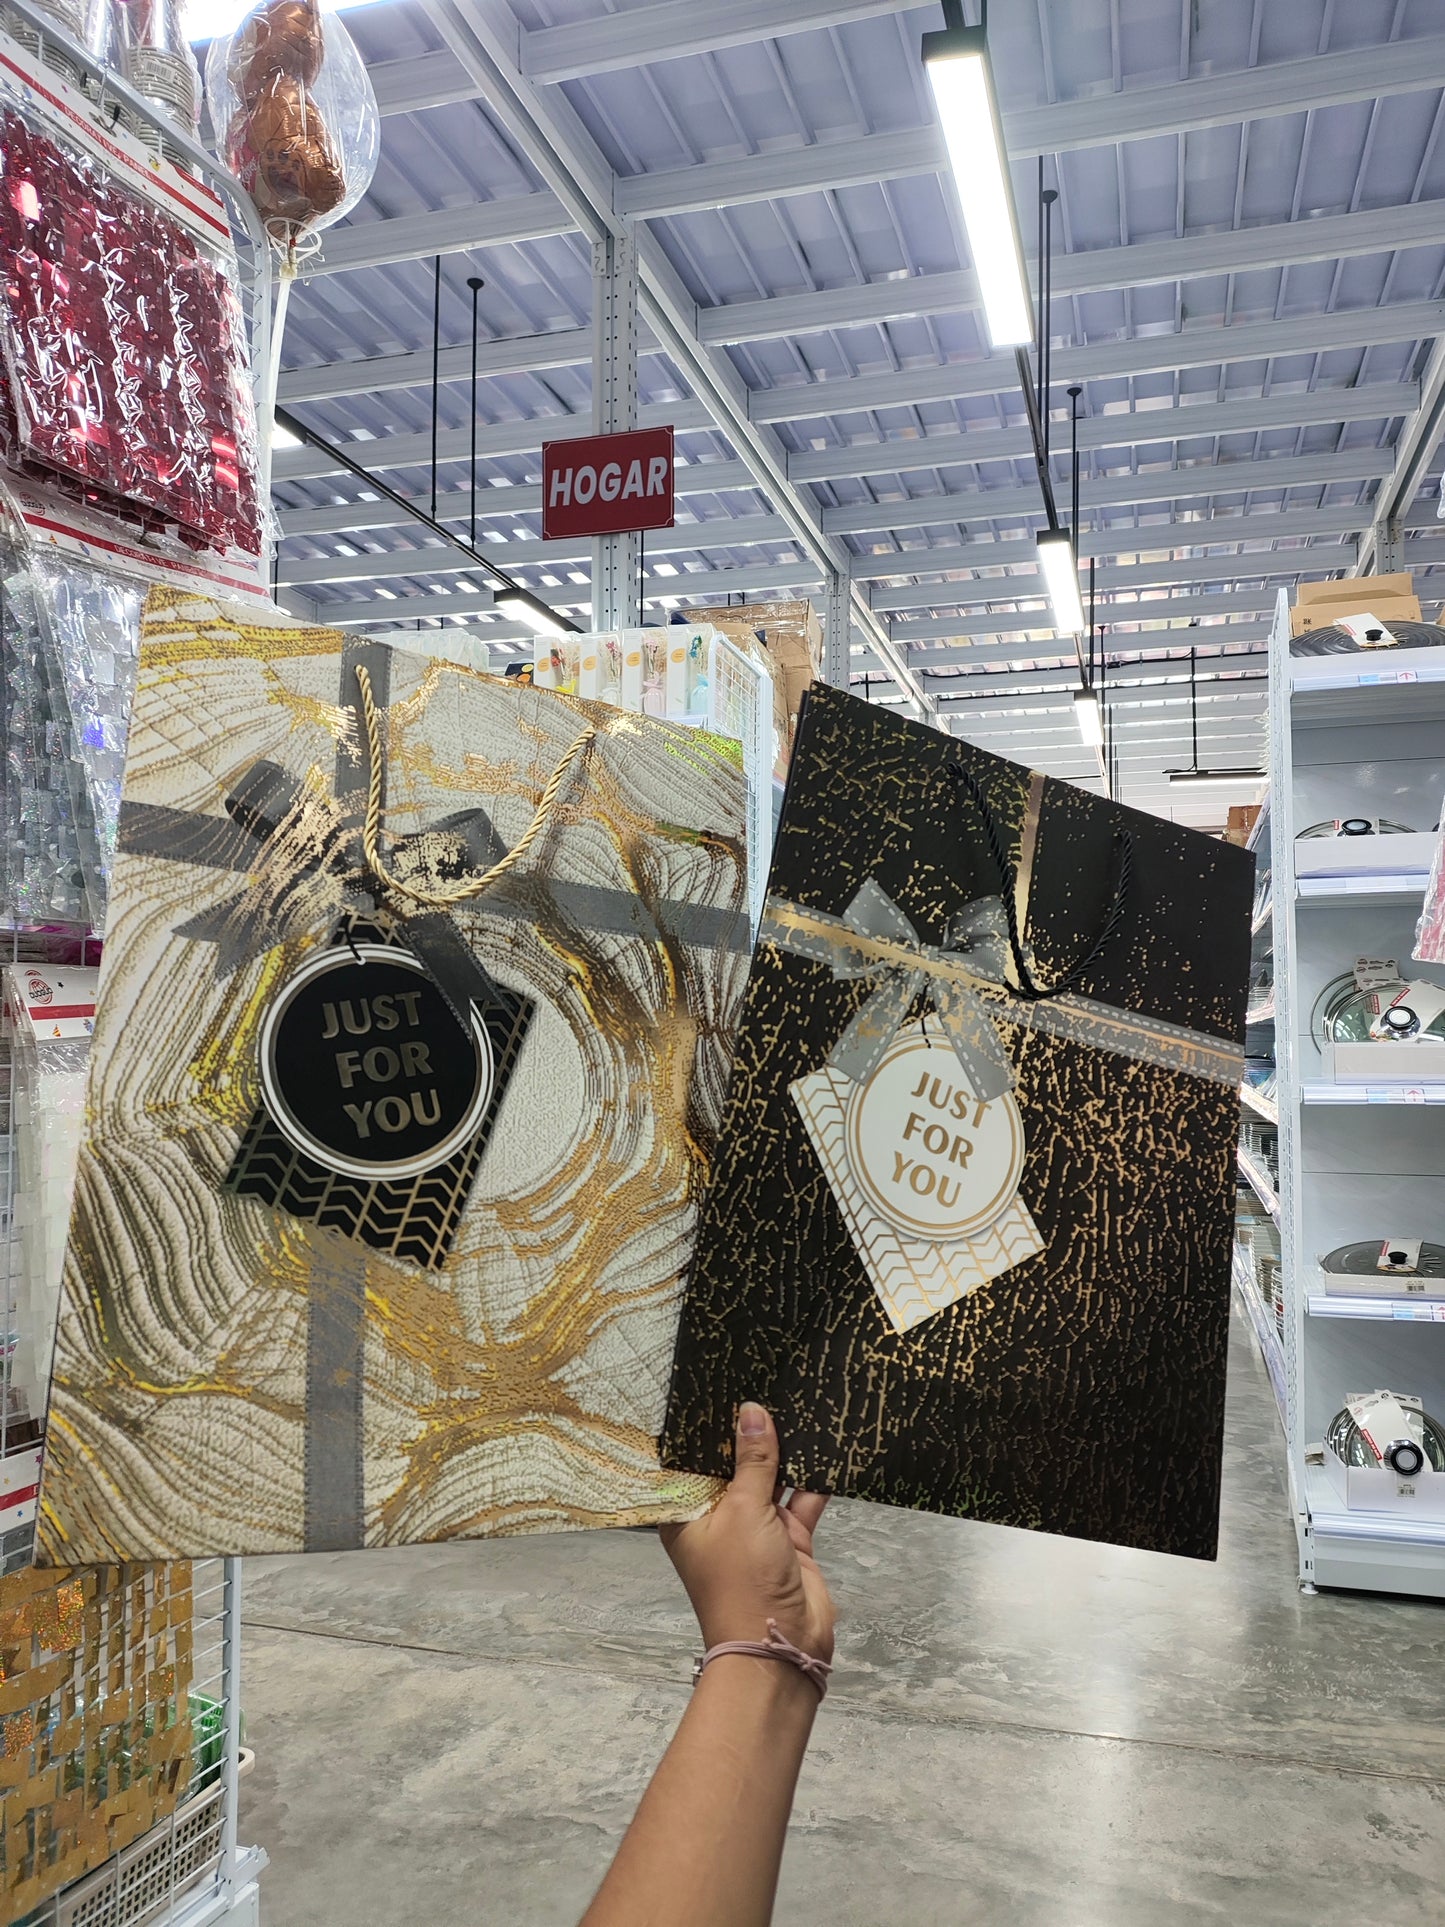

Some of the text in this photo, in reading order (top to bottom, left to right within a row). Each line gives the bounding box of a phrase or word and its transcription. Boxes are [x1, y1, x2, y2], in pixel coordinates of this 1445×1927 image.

[549, 456, 668, 507] HOGAR
[321, 991, 421, 1039] JUST
[335, 1041, 434, 1088] FOR
[342, 1089, 441, 1138] YOU
[910, 1071, 992, 1129] JUST
[902, 1112, 974, 1170] FOR
[892, 1150, 962, 1208] YOU
